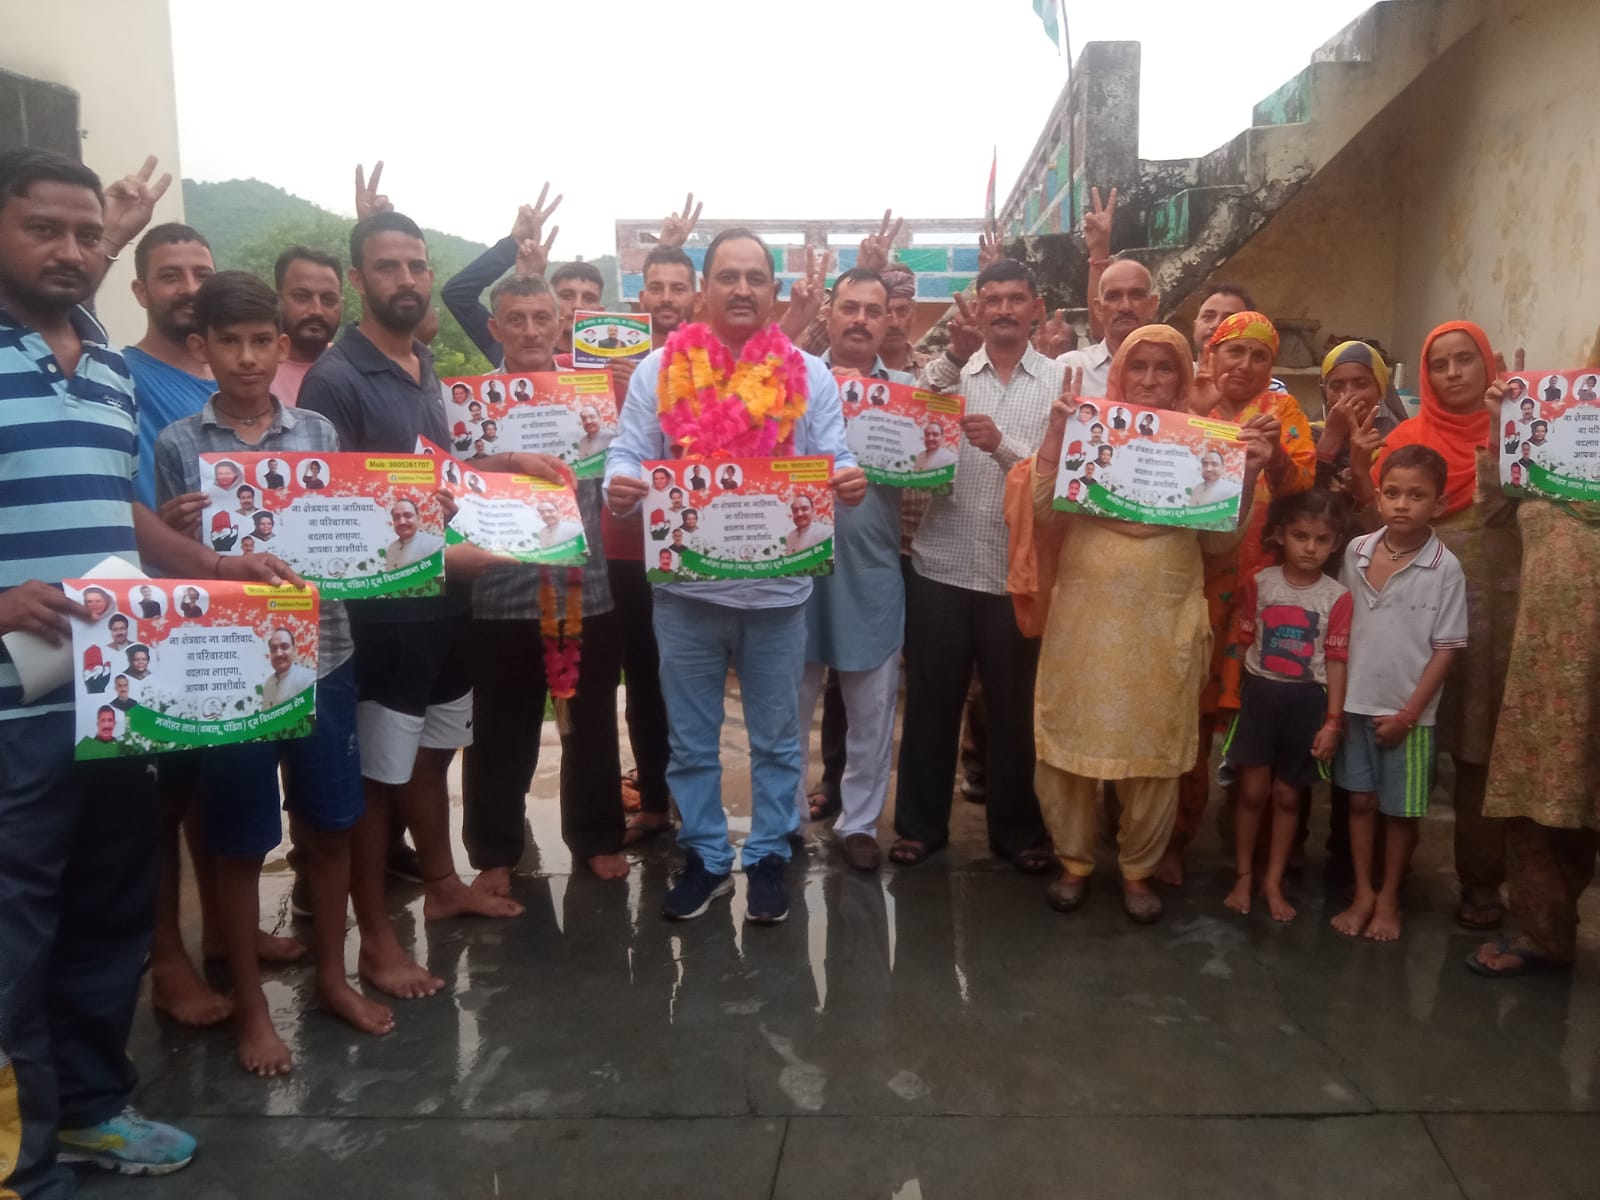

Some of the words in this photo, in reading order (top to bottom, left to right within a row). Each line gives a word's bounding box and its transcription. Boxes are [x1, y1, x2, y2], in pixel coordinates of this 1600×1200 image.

[1275, 626, 1305, 640] JUST
[169, 636, 179, 645] ना
[209, 635, 218, 643] ना
[187, 652, 195, 660] ना
[210, 678, 246, 691] आशीर्वाद
